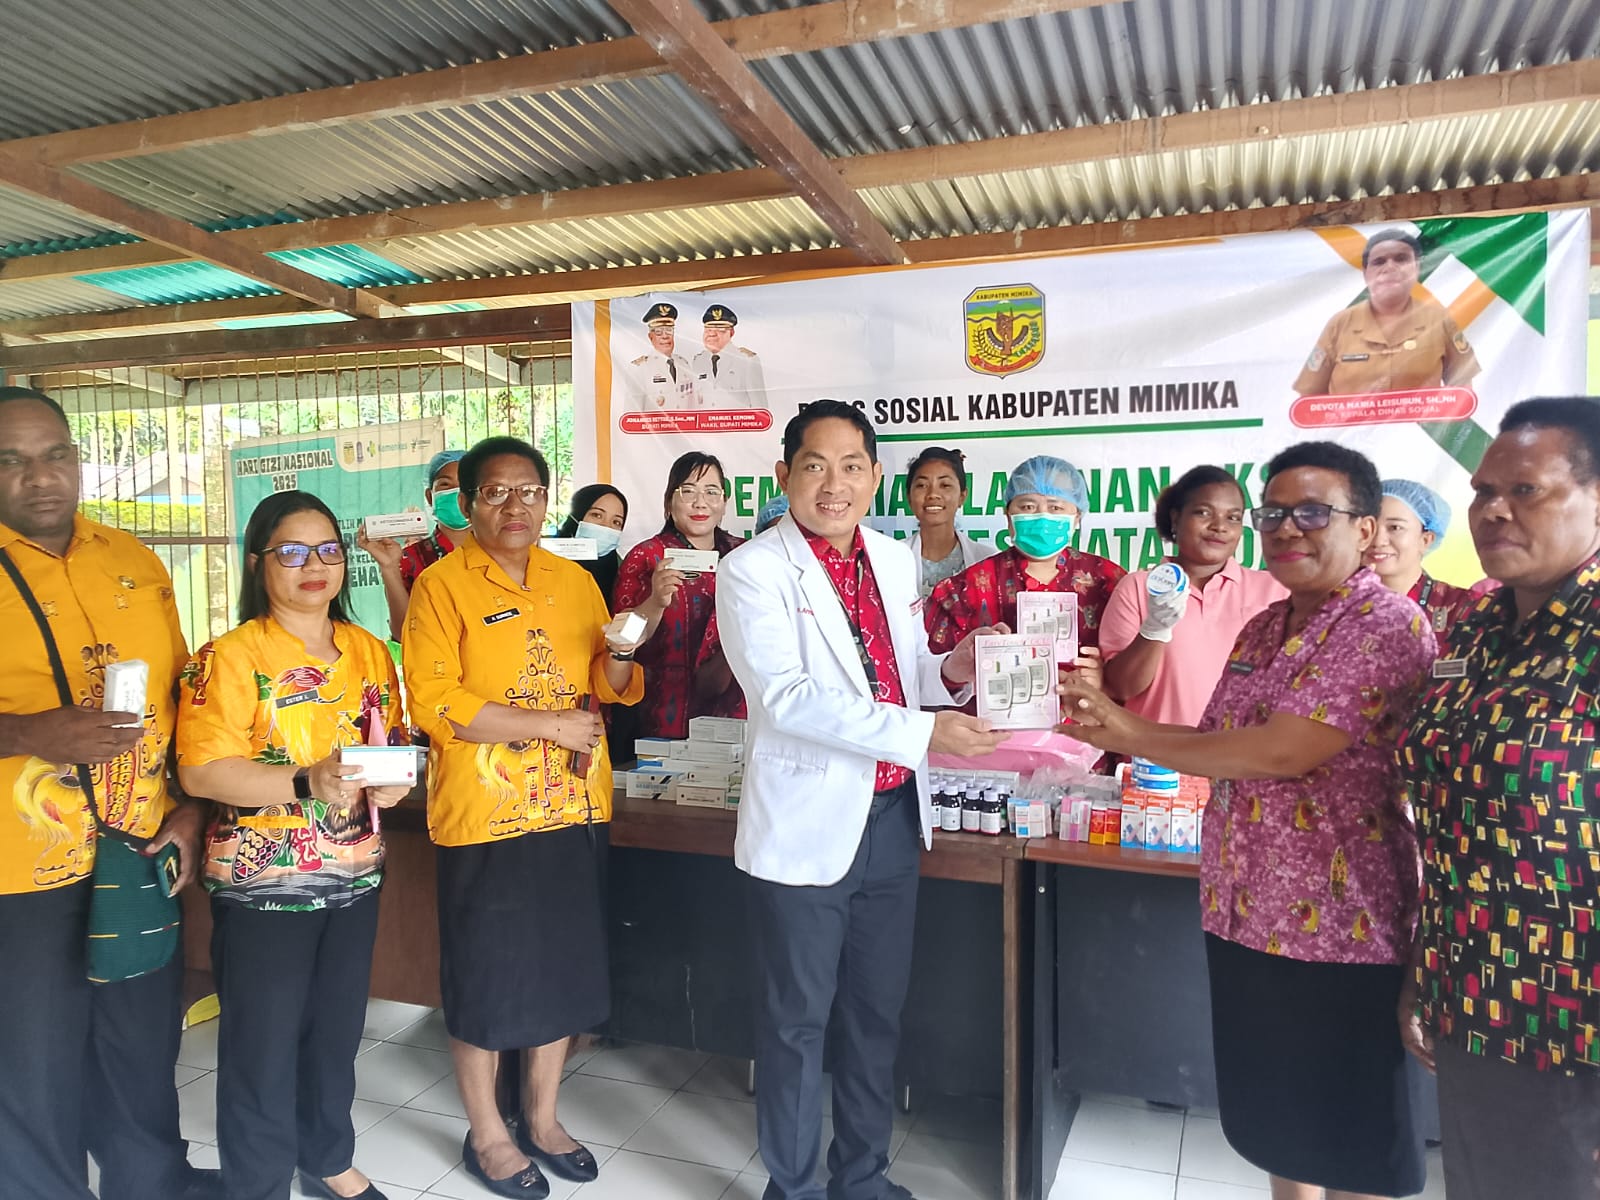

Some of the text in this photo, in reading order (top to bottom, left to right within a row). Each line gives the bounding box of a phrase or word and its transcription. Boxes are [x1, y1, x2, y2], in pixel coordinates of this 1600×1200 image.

[976, 292, 1010, 300] KABUPATEN
[874, 396, 960, 425] SOSIAL
[967, 386, 1120, 421] KABUPATEN
[1128, 380, 1240, 414] MIMIKA
[1310, 402, 1346, 412] DEVOTA
[1346, 400, 1376, 411] MARIA
[1377, 407, 1407, 417] DINAS
[1408, 405, 1441, 414] SOSIAL
[236, 450, 334, 476] HARI GIZI NASIONAL
[272, 474, 297, 491] 2025
